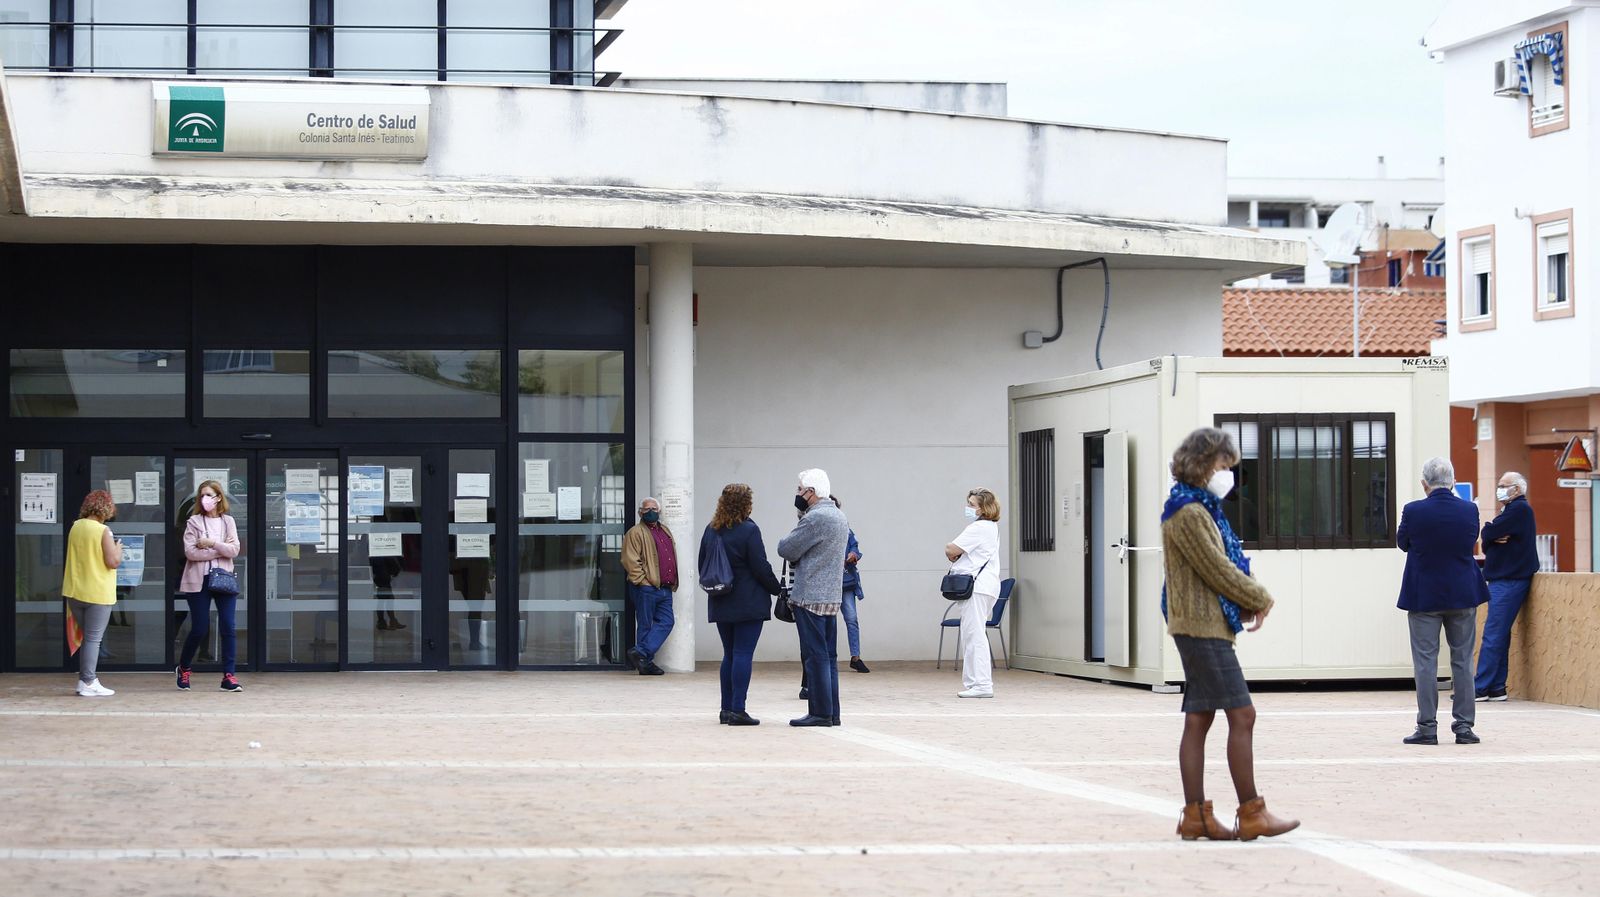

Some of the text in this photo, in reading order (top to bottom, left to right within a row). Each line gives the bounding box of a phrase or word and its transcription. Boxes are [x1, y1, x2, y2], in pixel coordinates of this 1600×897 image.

[306, 112, 416, 129] Centro de Salud
[299, 132, 330, 143] Colonia
[332, 132, 356, 143] Santa
